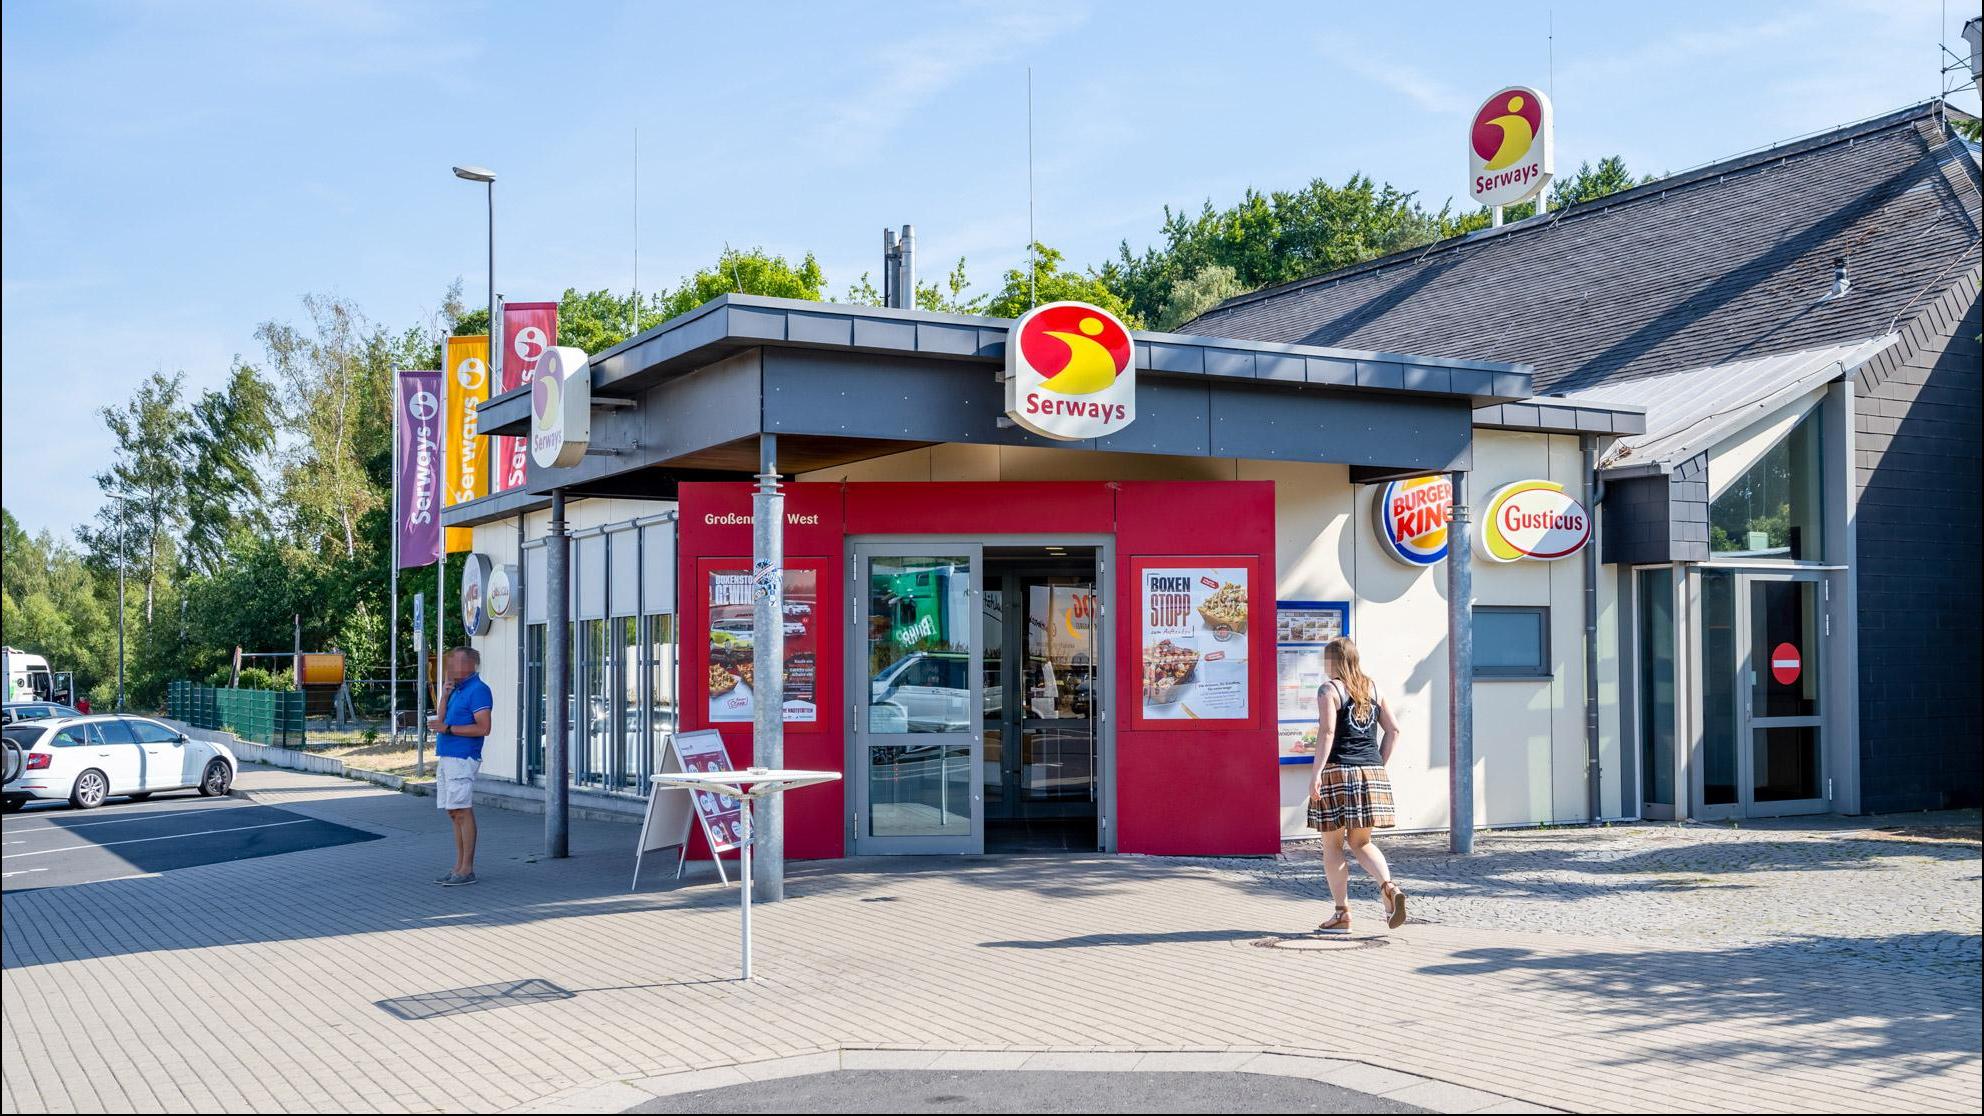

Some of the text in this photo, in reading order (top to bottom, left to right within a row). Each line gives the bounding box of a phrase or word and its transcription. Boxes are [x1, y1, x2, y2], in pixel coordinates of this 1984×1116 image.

[1476, 163, 1539, 194] Serways
[1026, 393, 1126, 425] Serways
[534, 430, 562, 452] Serways
[411, 426, 437, 525] Serways
[1393, 483, 1453, 517] BURGER
[787, 513, 819, 525] West
[1396, 500, 1454, 543] KING
[1504, 505, 1583, 532] Gusticus
[1151, 577, 1190, 592] BOXEN
[1151, 594, 1190, 627] STOPP
